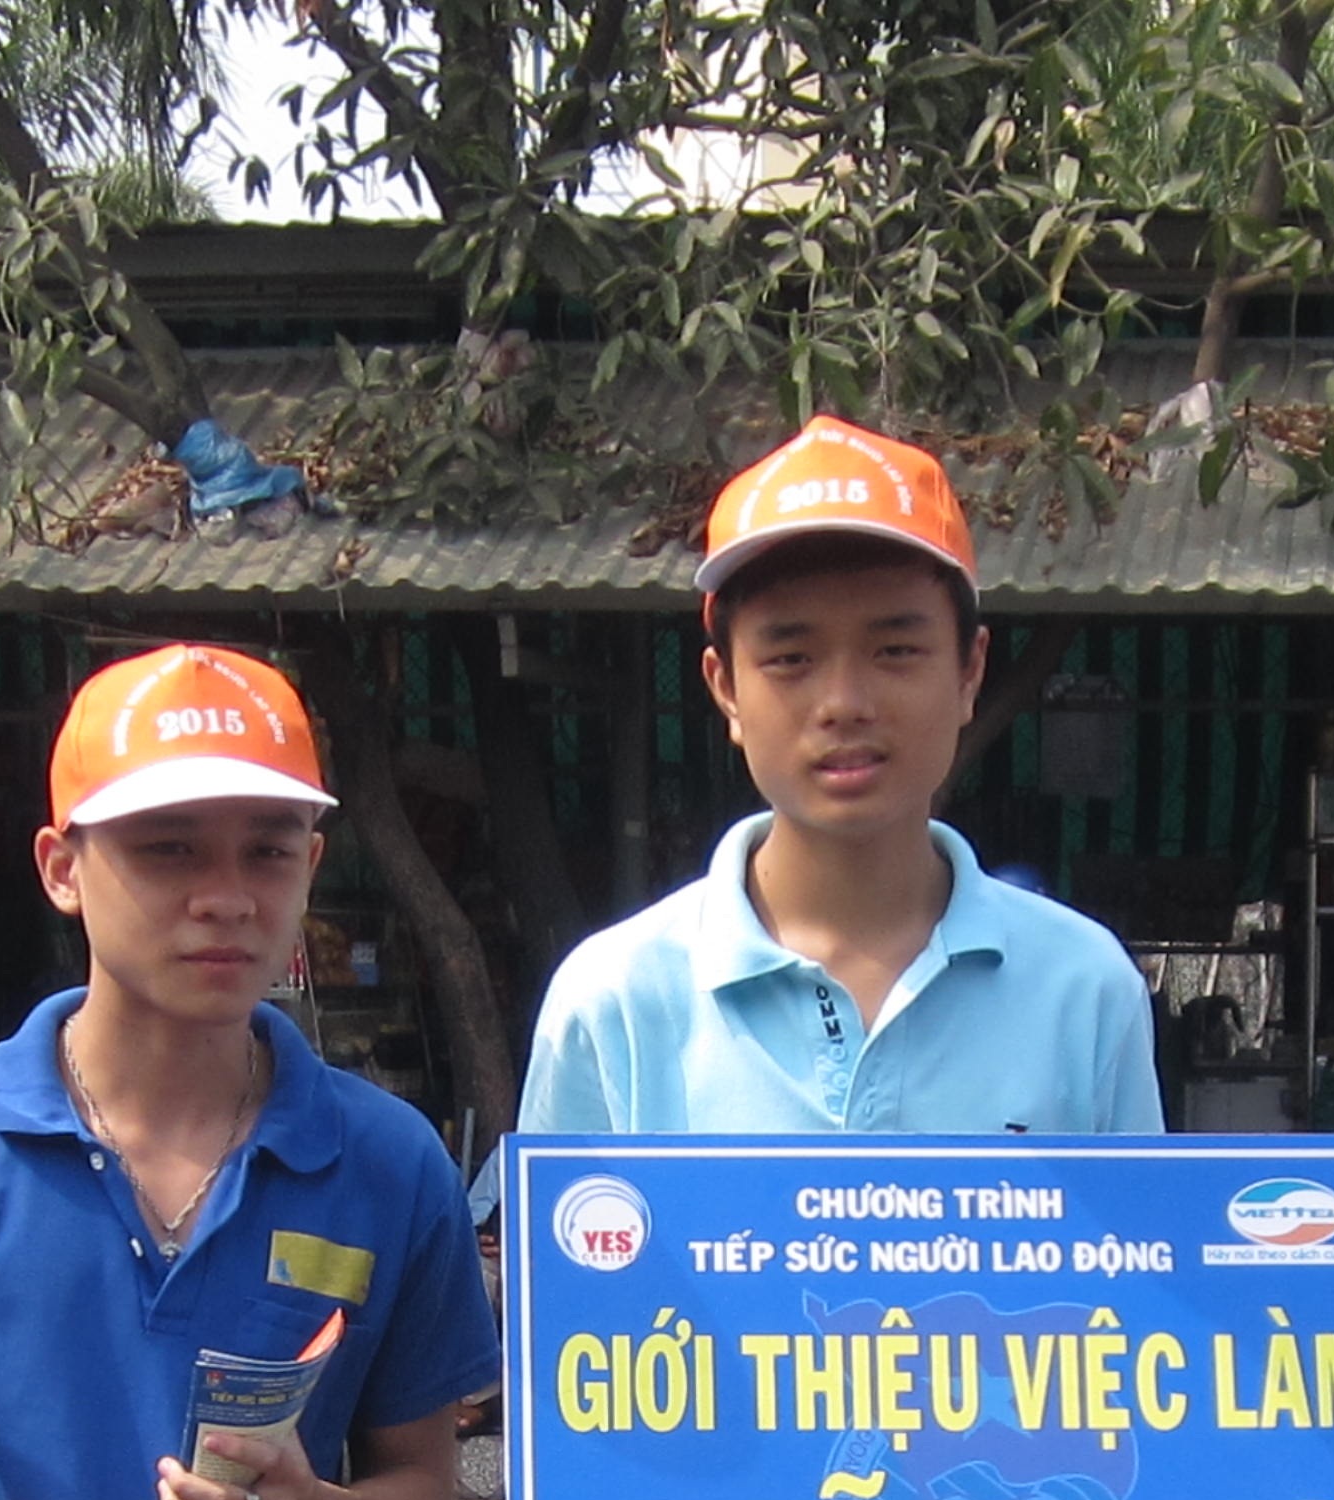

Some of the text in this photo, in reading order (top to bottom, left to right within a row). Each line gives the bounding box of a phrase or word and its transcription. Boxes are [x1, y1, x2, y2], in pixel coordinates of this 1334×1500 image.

[776, 478, 869, 514] 2015
[155, 707, 246, 743] 2015
[795, 1179, 1065, 1221] CHƯƠNG TRÌNH
[582, 1229, 633, 1254] YES
[688, 1228, 1174, 1279] TIẾP SỨC NGƯỜI LAO ĐỘNG
[1258, 1248, 1286, 1260] theo
[1291, 1248, 1321, 1260] cách
[556, 1307, 716, 1432] GIỚI
[741, 1307, 979, 1450] THIỆU
[1006, 1307, 1187, 1450] VIỆC
